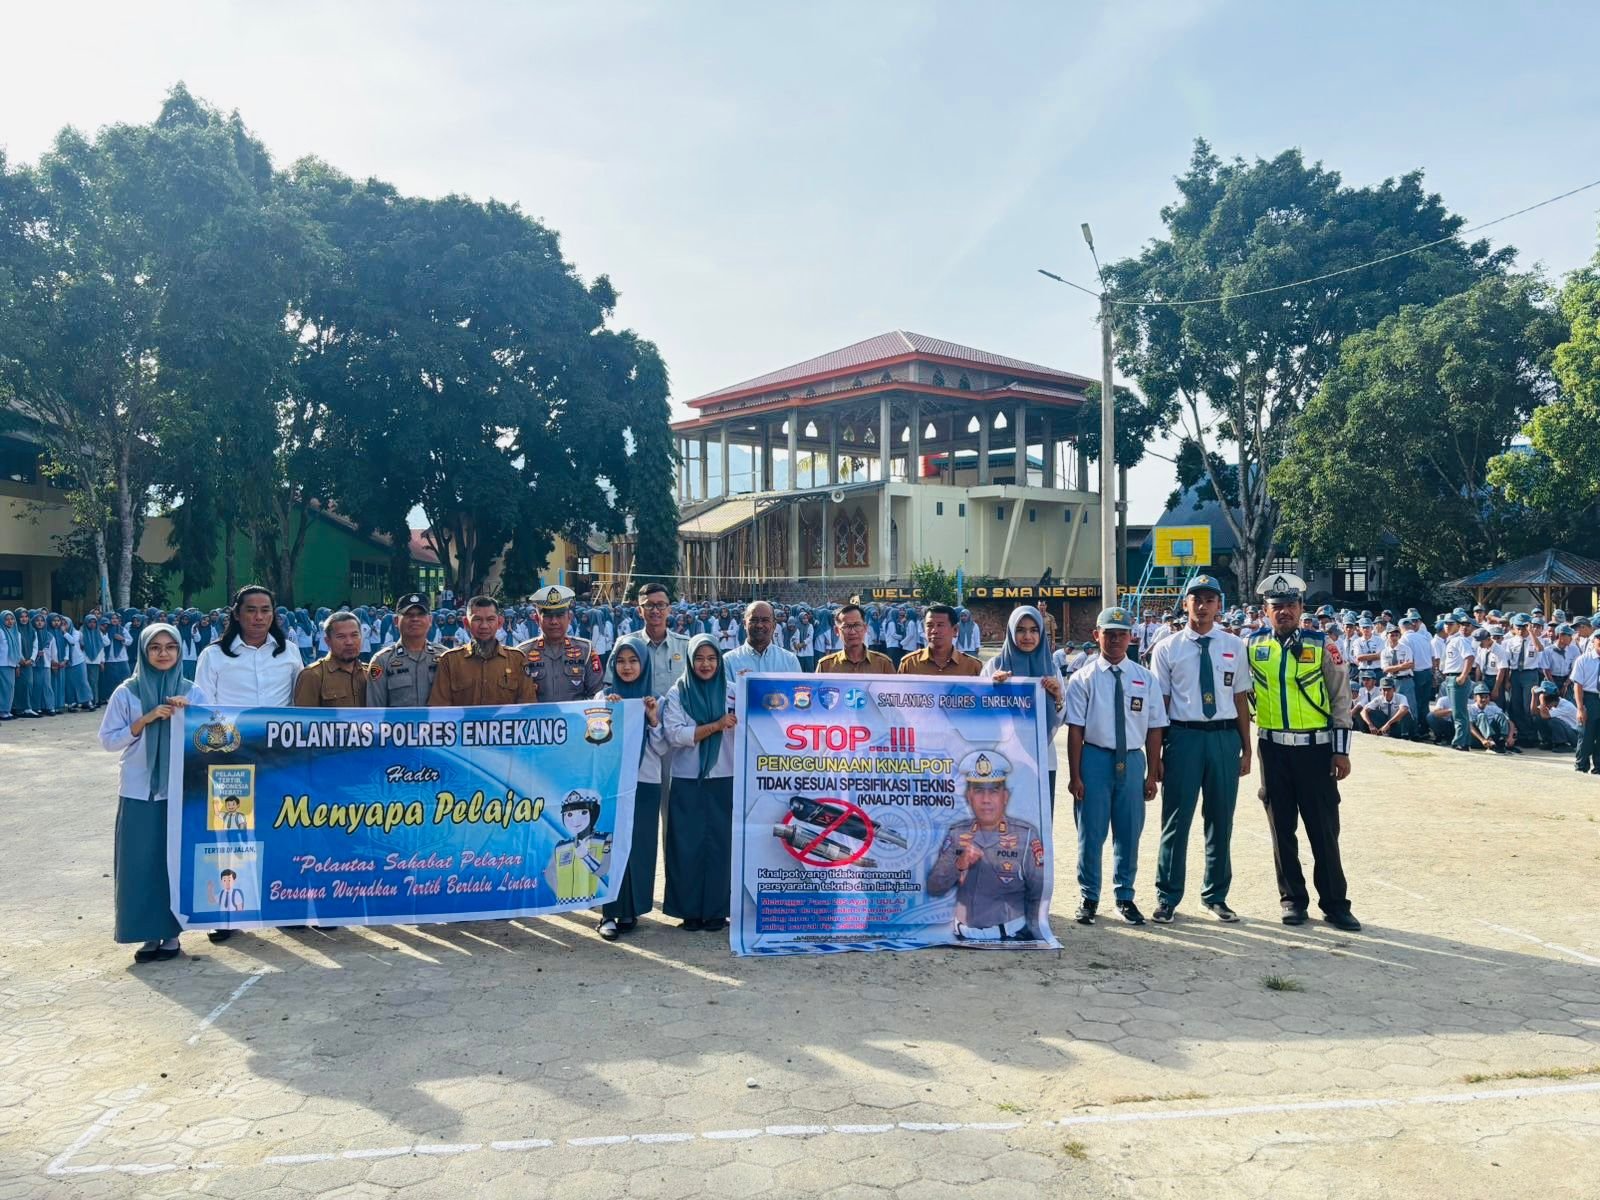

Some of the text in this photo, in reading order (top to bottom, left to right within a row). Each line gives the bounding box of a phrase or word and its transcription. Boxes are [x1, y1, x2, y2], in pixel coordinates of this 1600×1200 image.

[992, 587, 1033, 597] SMA
[877, 693, 1031, 709] SATLANTAS POLRES ENREKANG
[267, 717, 568, 748] POLANTAS POLRES ENREKANG
[756, 755, 954, 775] PENGGUNAAN KNALPOT
[386, 764, 440, 784] Hadir
[756, 777, 955, 793] TIDAK SESUAI SPESIFIKASI TEKNIS
[857, 794, 955, 810] (KNALPOT BRONG)
[273, 788, 546, 835] Menyapa Pelajar
[383, 853, 454, 870] Sahabat
[460, 851, 523, 869] Pelajar
[758, 868, 911, 881] Knalpot yang tidak memenuhi
[270, 880, 327, 901] Bersama
[332, 878, 398, 902] Wujudkan
[403, 875, 442, 897] Tertib
[447, 873, 493, 895] Berlalu
[758, 882, 819, 893] persyaratan
[820, 882, 854, 892] teknis
[855, 882, 876, 892] dan
